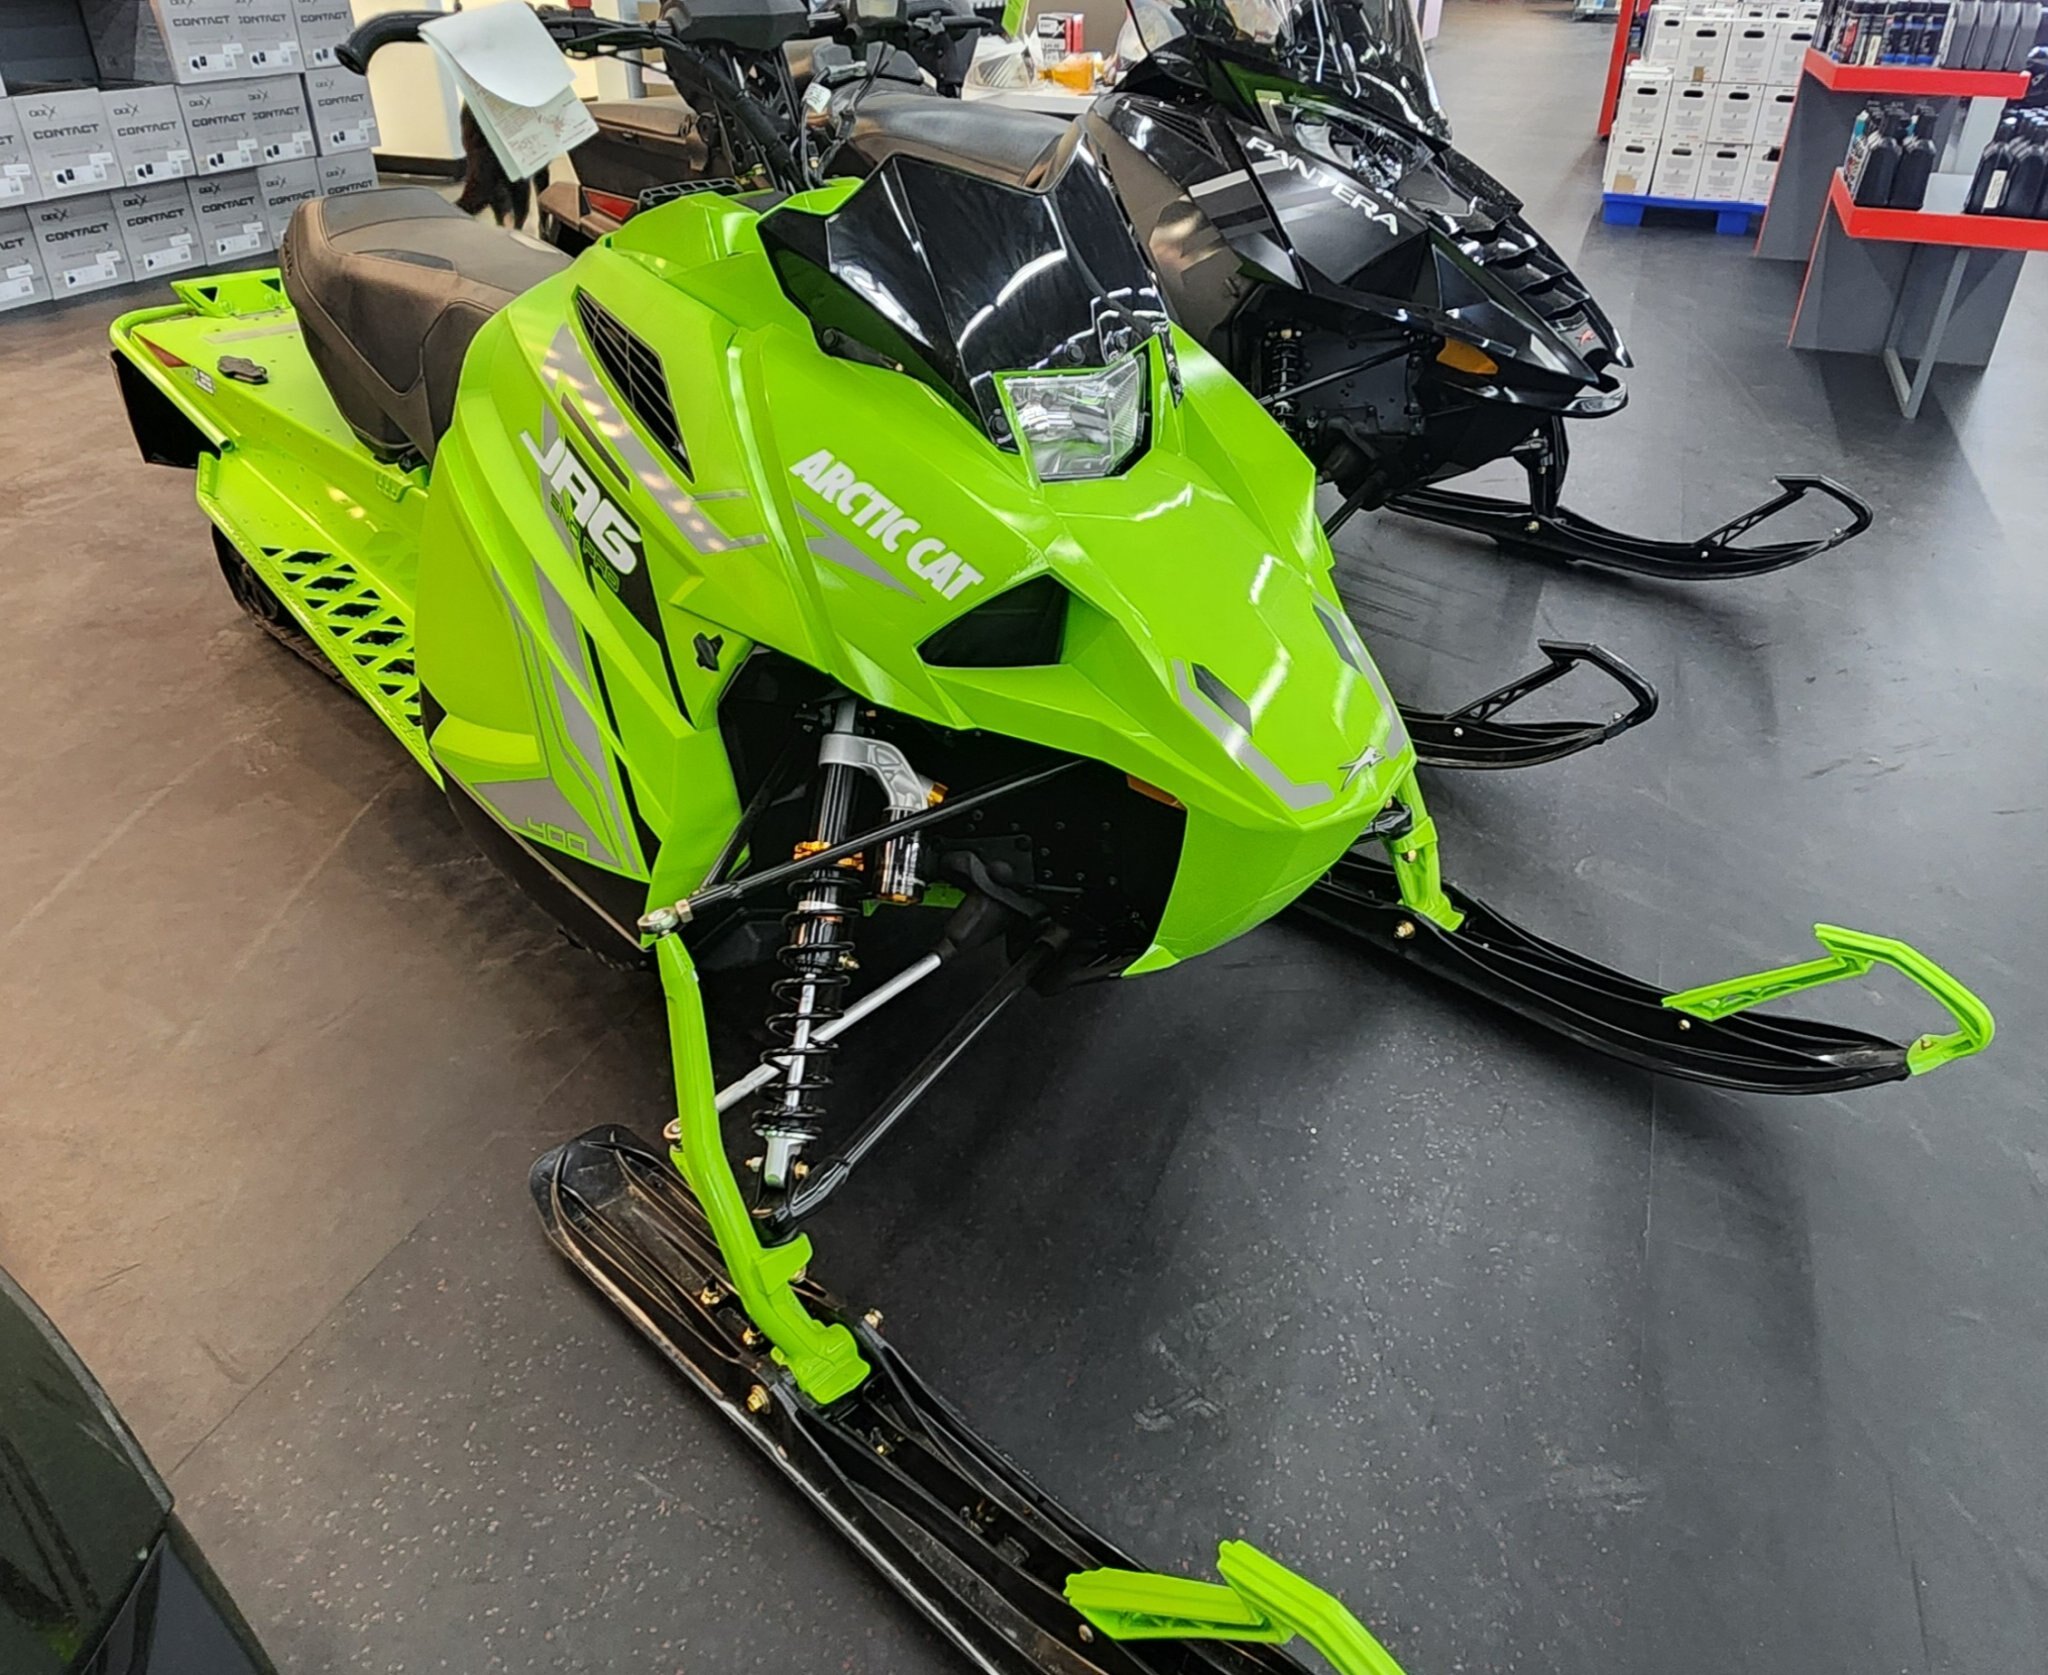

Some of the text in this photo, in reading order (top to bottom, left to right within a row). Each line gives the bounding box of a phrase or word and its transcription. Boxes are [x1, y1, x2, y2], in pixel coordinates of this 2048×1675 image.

[173, 15, 230, 27] CONTACT
[301, 11, 348, 23] CONTACT
[318, 93, 364, 108] CONTACT
[117, 121, 177, 137] CONTACT
[192, 113, 247, 128] CONTACT
[33, 124, 100, 140] CONTACT
[327, 180, 374, 196] CONTACT
[1246, 136, 1398, 236] PANTERA
[201, 196, 256, 214] CONTACT
[269, 189, 316, 206] CONTACT
[126, 208, 185, 227] CONTACT
[45, 222, 110, 243] CONTACT
[789, 448, 985, 601] ARCTIC CAT
[583, 536, 620, 593] PRO
[526, 816, 588, 858] 400
